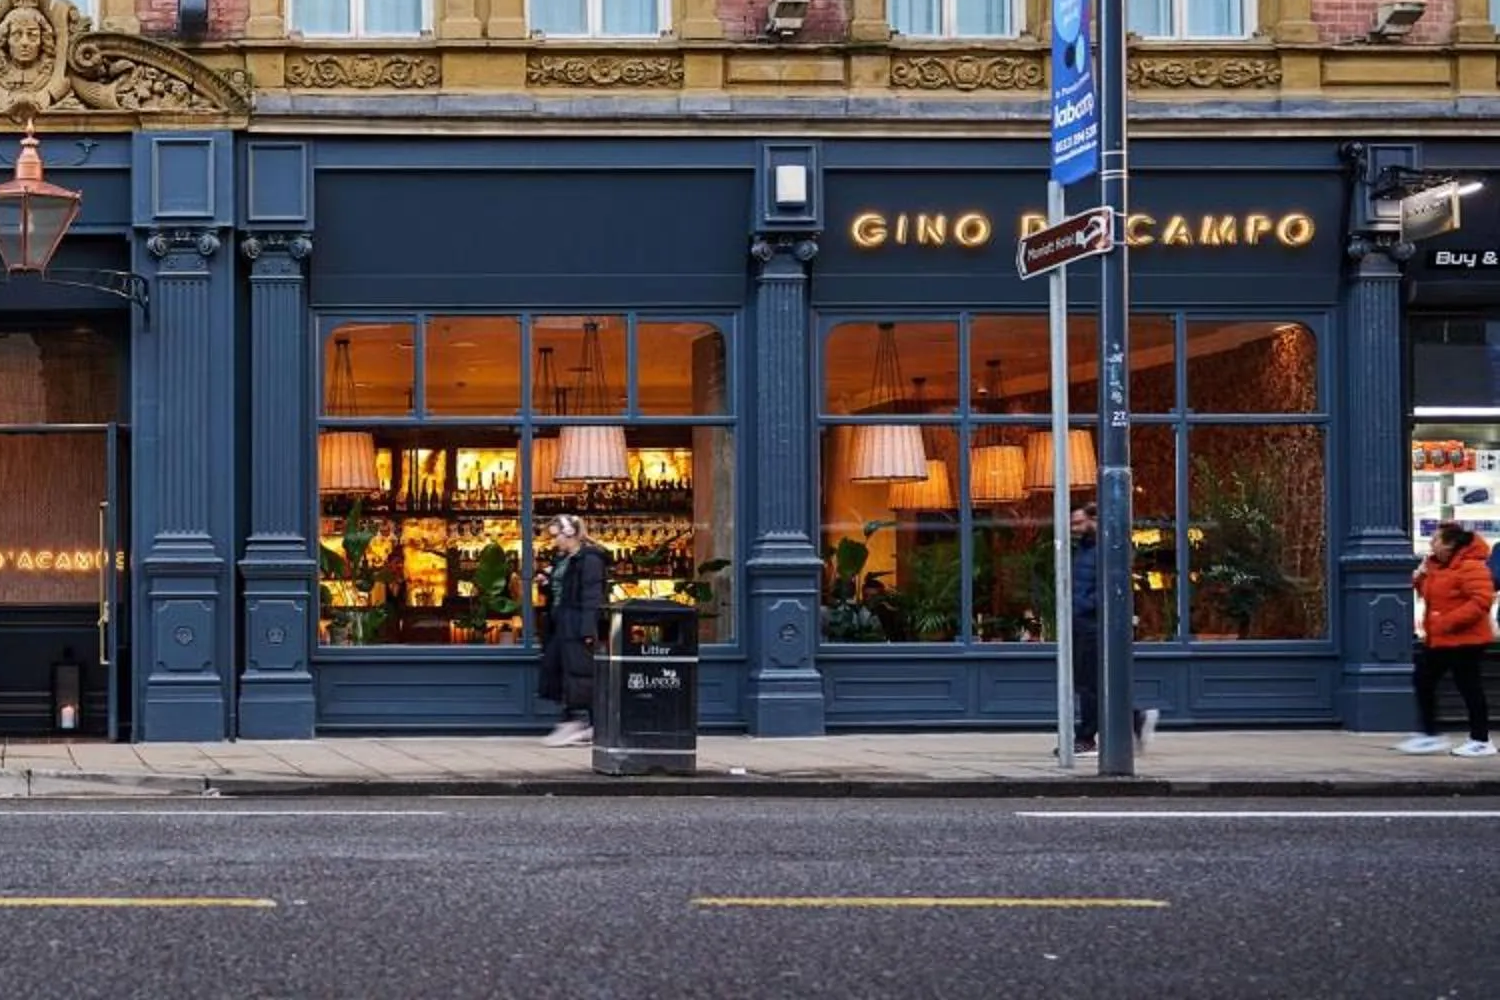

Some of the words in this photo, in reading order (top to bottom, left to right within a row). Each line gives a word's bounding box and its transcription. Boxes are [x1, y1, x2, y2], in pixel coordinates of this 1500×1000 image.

[851, 212, 991, 247] GINO
[1021, 212, 1315, 247] DCAMPO
[1435, 250, 1477, 267] Buy
[1482, 250, 1498, 265] &
[641, 644, 671, 656] Litter
